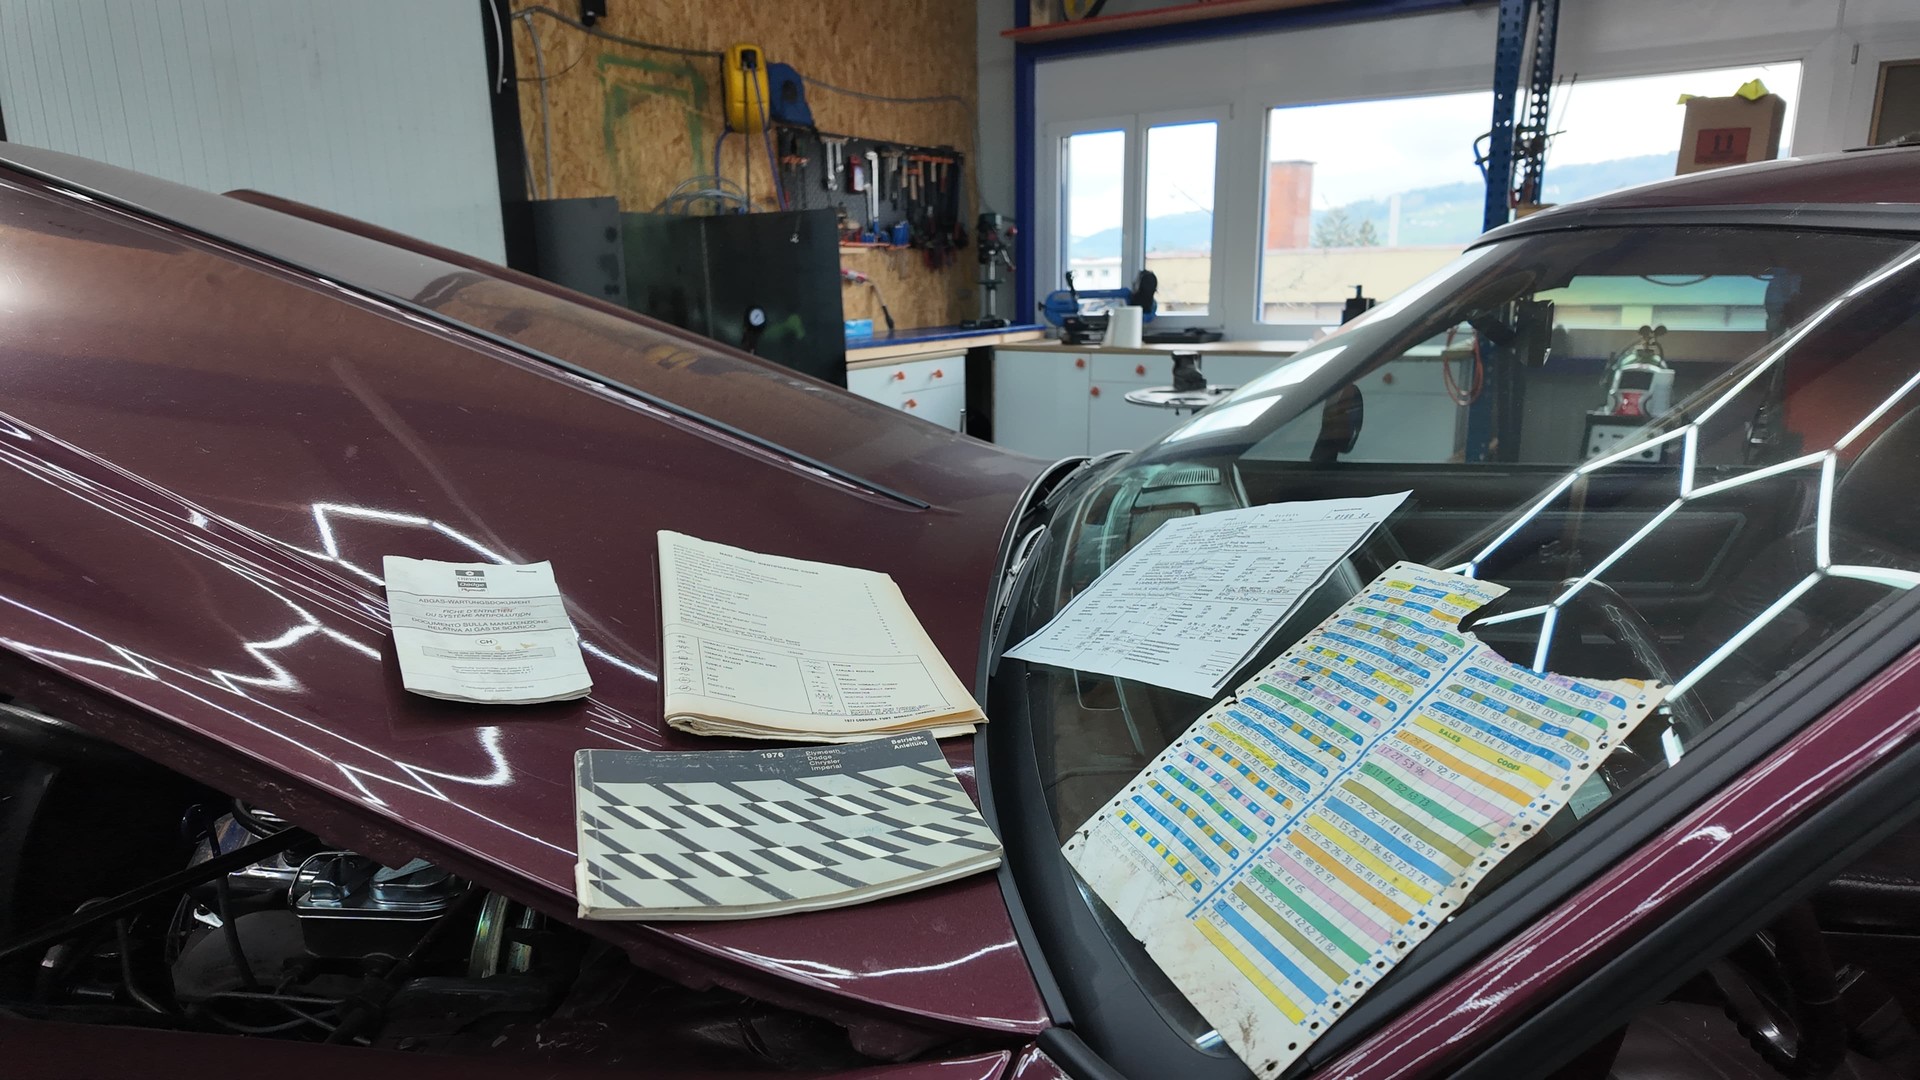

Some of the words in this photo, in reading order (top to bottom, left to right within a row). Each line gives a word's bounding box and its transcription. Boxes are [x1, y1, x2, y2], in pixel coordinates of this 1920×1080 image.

[411, 617, 460, 627] DOCUMENTO
[1421, 656, 1432, 665] 15
[1388, 688, 1399, 696] 17
[1478, 658, 1492, 667] 661
[1542, 684, 1553, 692] 61
[1555, 689, 1567, 697] 60
[1567, 693, 1581, 702] 83
[1595, 701, 1607, 710] 55
[1308, 719, 1319, 727] 15
[1427, 708, 1438, 717] 55
[1438, 714, 1449, 722] 55
[1449, 719, 1461, 728] 60
[1461, 724, 1472, 733] 70
[1472, 730, 1484, 739] 30
[1484, 736, 1496, 744] 14
[1497, 741, 1509, 750] 79
[1510, 748, 1522, 758] 78
[1444, 692, 1454, 700] 61
[1466, 701, 1478, 710] 08
[1490, 712, 1501, 720] 83
[1560, 742, 1585, 758] 2070
[805, 748, 840, 756] Plymouth
[891, 736, 924, 745] Betriebs-
[894, 740, 928, 750] Anleitung
[1271, 746, 1281, 755] 55
[1439, 729, 1461, 742] SALES
[1497, 758, 1520, 770] CODES
[1380, 747, 1392, 755] 17
[1390, 752, 1403, 761] 27
[1402, 758, 1415, 769] 53
[1415, 767, 1425, 776] 96
[1389, 740, 1402, 748] 15
[1400, 745, 1411, 753] 16
[1411, 750, 1422, 760] 56
[1424, 758, 1435, 767] 91
[1437, 765, 1448, 775] 92
[1449, 773, 1460, 781] 97
[1372, 769, 1383, 777] 11
[1384, 776, 1395, 785] 41
[1395, 783, 1408, 794] 52
[1408, 792, 1419, 800] 63
[1419, 797, 1430, 807] 73
[1336, 789, 1345, 798] 11
[1345, 795, 1357, 804] 15
[1356, 801, 1368, 811] 22
[1366, 809, 1379, 819] 25
[1378, 817, 1389, 826] 31
[1390, 825, 1400, 834] 41
[1401, 833, 1412, 843] 46
[1414, 840, 1425, 852] 52
[1426, 848, 1437, 858] 93
[1303, 825, 1312, 834] 05
[1311, 832, 1321, 841] 21
[1320, 839, 1332, 849] 25
[1331, 846, 1341, 856] 26
[1342, 855, 1353, 865] 31
[1354, 863, 1365, 873] 55
[1365, 872, 1375, 881] 81
[1377, 879, 1387, 889] 83
[1319, 808, 1330, 817] 05
[1329, 814, 1339, 823] 11
[1339, 821, 1350, 831] 15
[1348, 827, 1360, 838] 25
[1360, 835, 1370, 845] 31
[1371, 843, 1381, 854] 36
[1382, 852, 1395, 862] 65
[1395, 860, 1407, 871] 72
[1406, 867, 1417, 877] 73
[1418, 874, 1429, 885] 76
[1264, 859, 1276, 868] 25
[1274, 867, 1284, 876] 31
[1285, 876, 1295, 885] 41
[1295, 884, 1306, 893] 45
[1305, 857, 1314, 867] 88
[1314, 865, 1324, 875] 92
[1325, 874, 1336, 883] 97
[1208, 911, 1219, 920] 14
[1217, 919, 1229, 928] 37
[1218, 901, 1228, 911] 21
[1236, 902, 1247, 911] 24
[1247, 875, 1257, 885] 02
[1256, 884, 1267, 894] 13
[1264, 892, 1277, 903] 25
[1274, 901, 1286, 910] 32
[1285, 910, 1294, 918] 41
[1295, 918, 1306, 928] 42
[1304, 925, 1316, 936] 62
[1315, 934, 1327, 944] 77
[1325, 943, 1336, 953] 82
